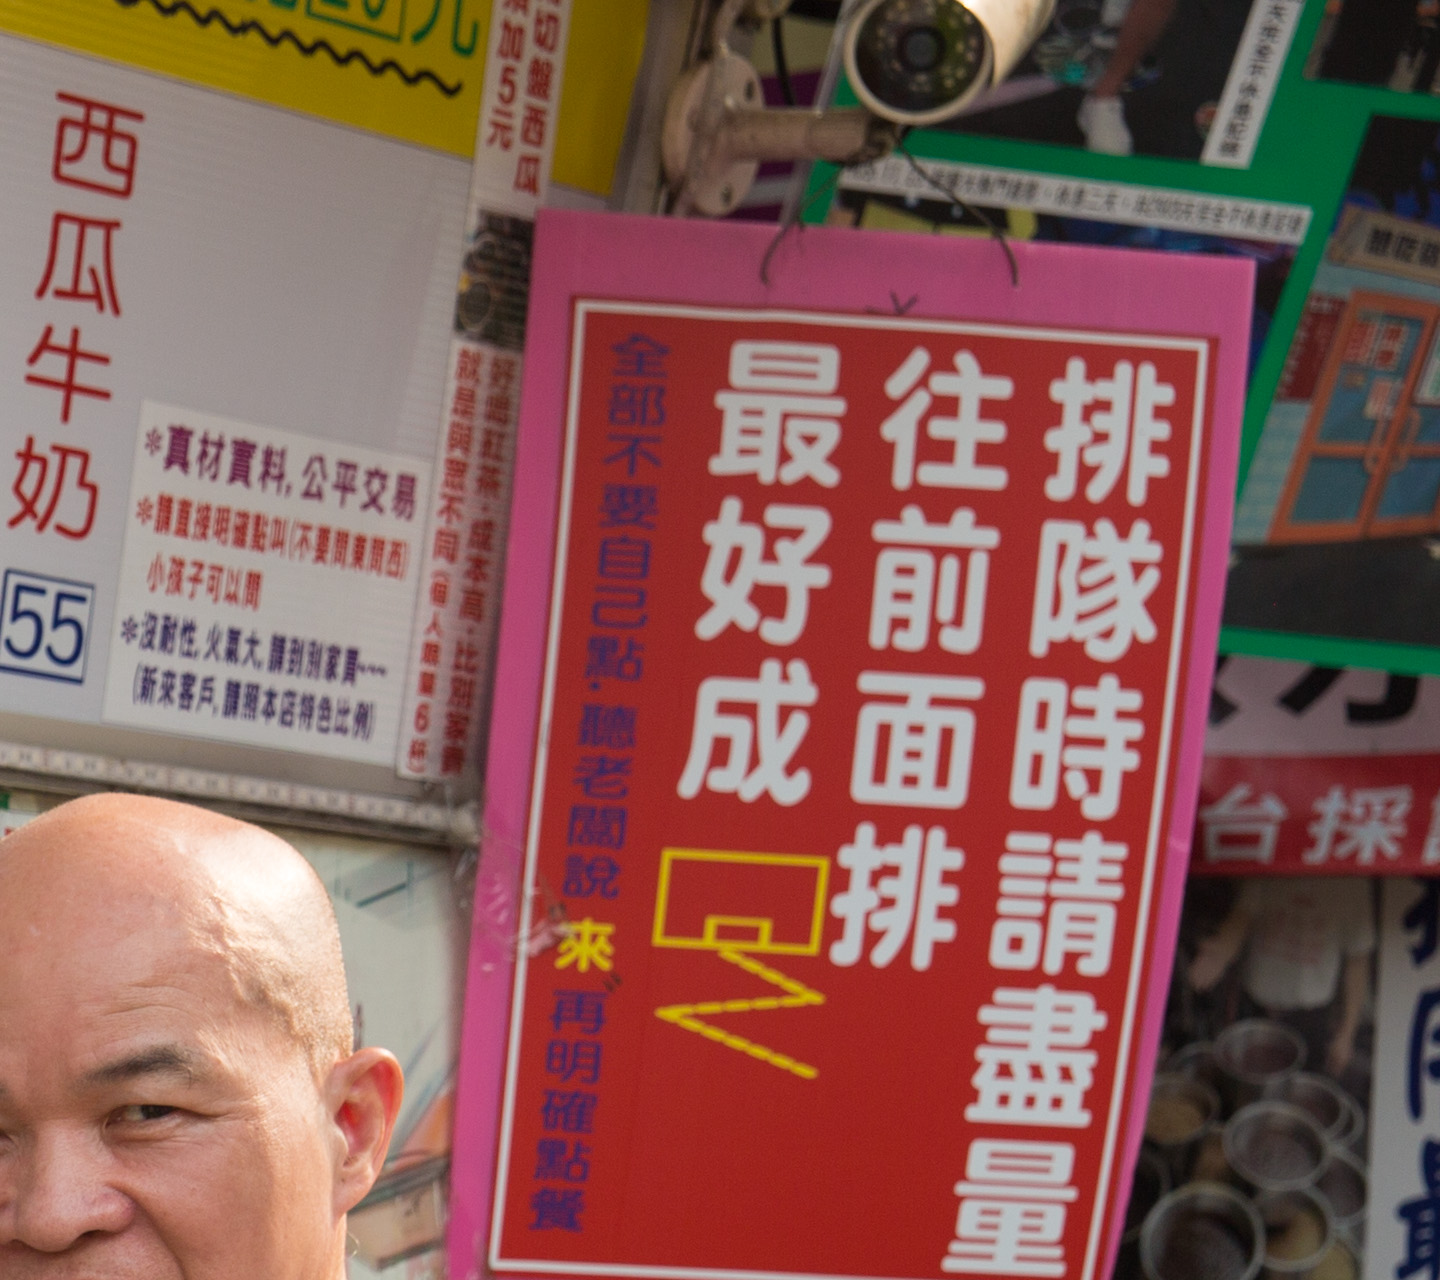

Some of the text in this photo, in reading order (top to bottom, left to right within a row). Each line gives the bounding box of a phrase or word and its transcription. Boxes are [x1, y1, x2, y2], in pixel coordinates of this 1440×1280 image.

[6, 90, 146, 542] 西瓜牛奶
[3, 583, 84, 668] 55
[676, 339, 848, 806] 最好成
[830, 348, 1015, 974] 往前面排
[942, 356, 1176, 1277] 排隊時請盡量
